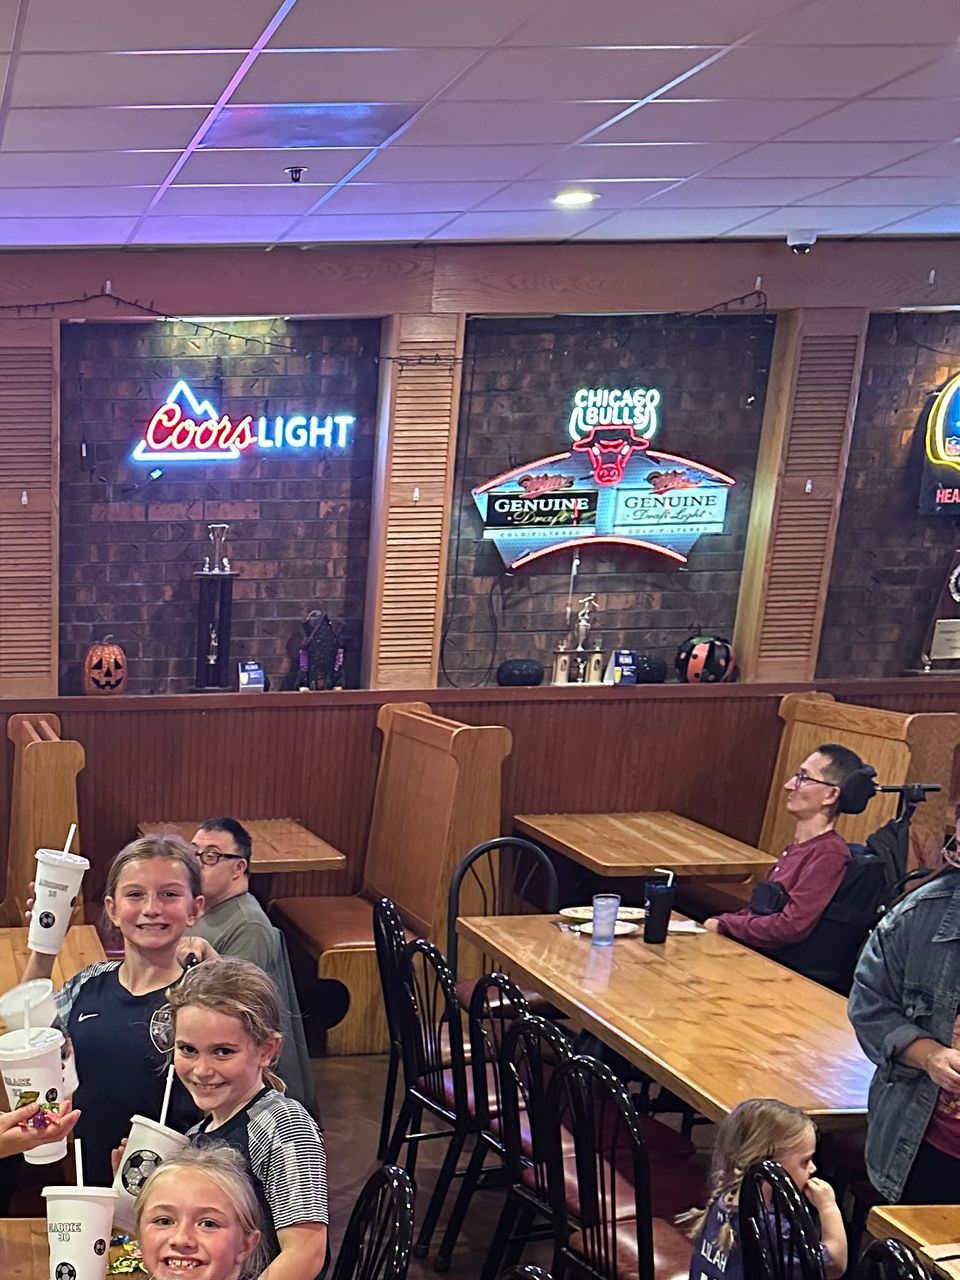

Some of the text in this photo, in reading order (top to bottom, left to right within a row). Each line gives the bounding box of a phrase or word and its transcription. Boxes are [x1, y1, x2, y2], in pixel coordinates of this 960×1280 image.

[574, 388, 661, 408] CHICAGO
[585, 406, 644, 425] BULLS
[146, 402, 355, 450] Coors LIGHT
[494, 498, 589, 512] GENUINE
[624, 495, 717, 508] GENUINE
[513, 510, 568, 526] Draft
[670, 508, 707, 523] Light
[701, 1239, 728, 1273] LILAH
